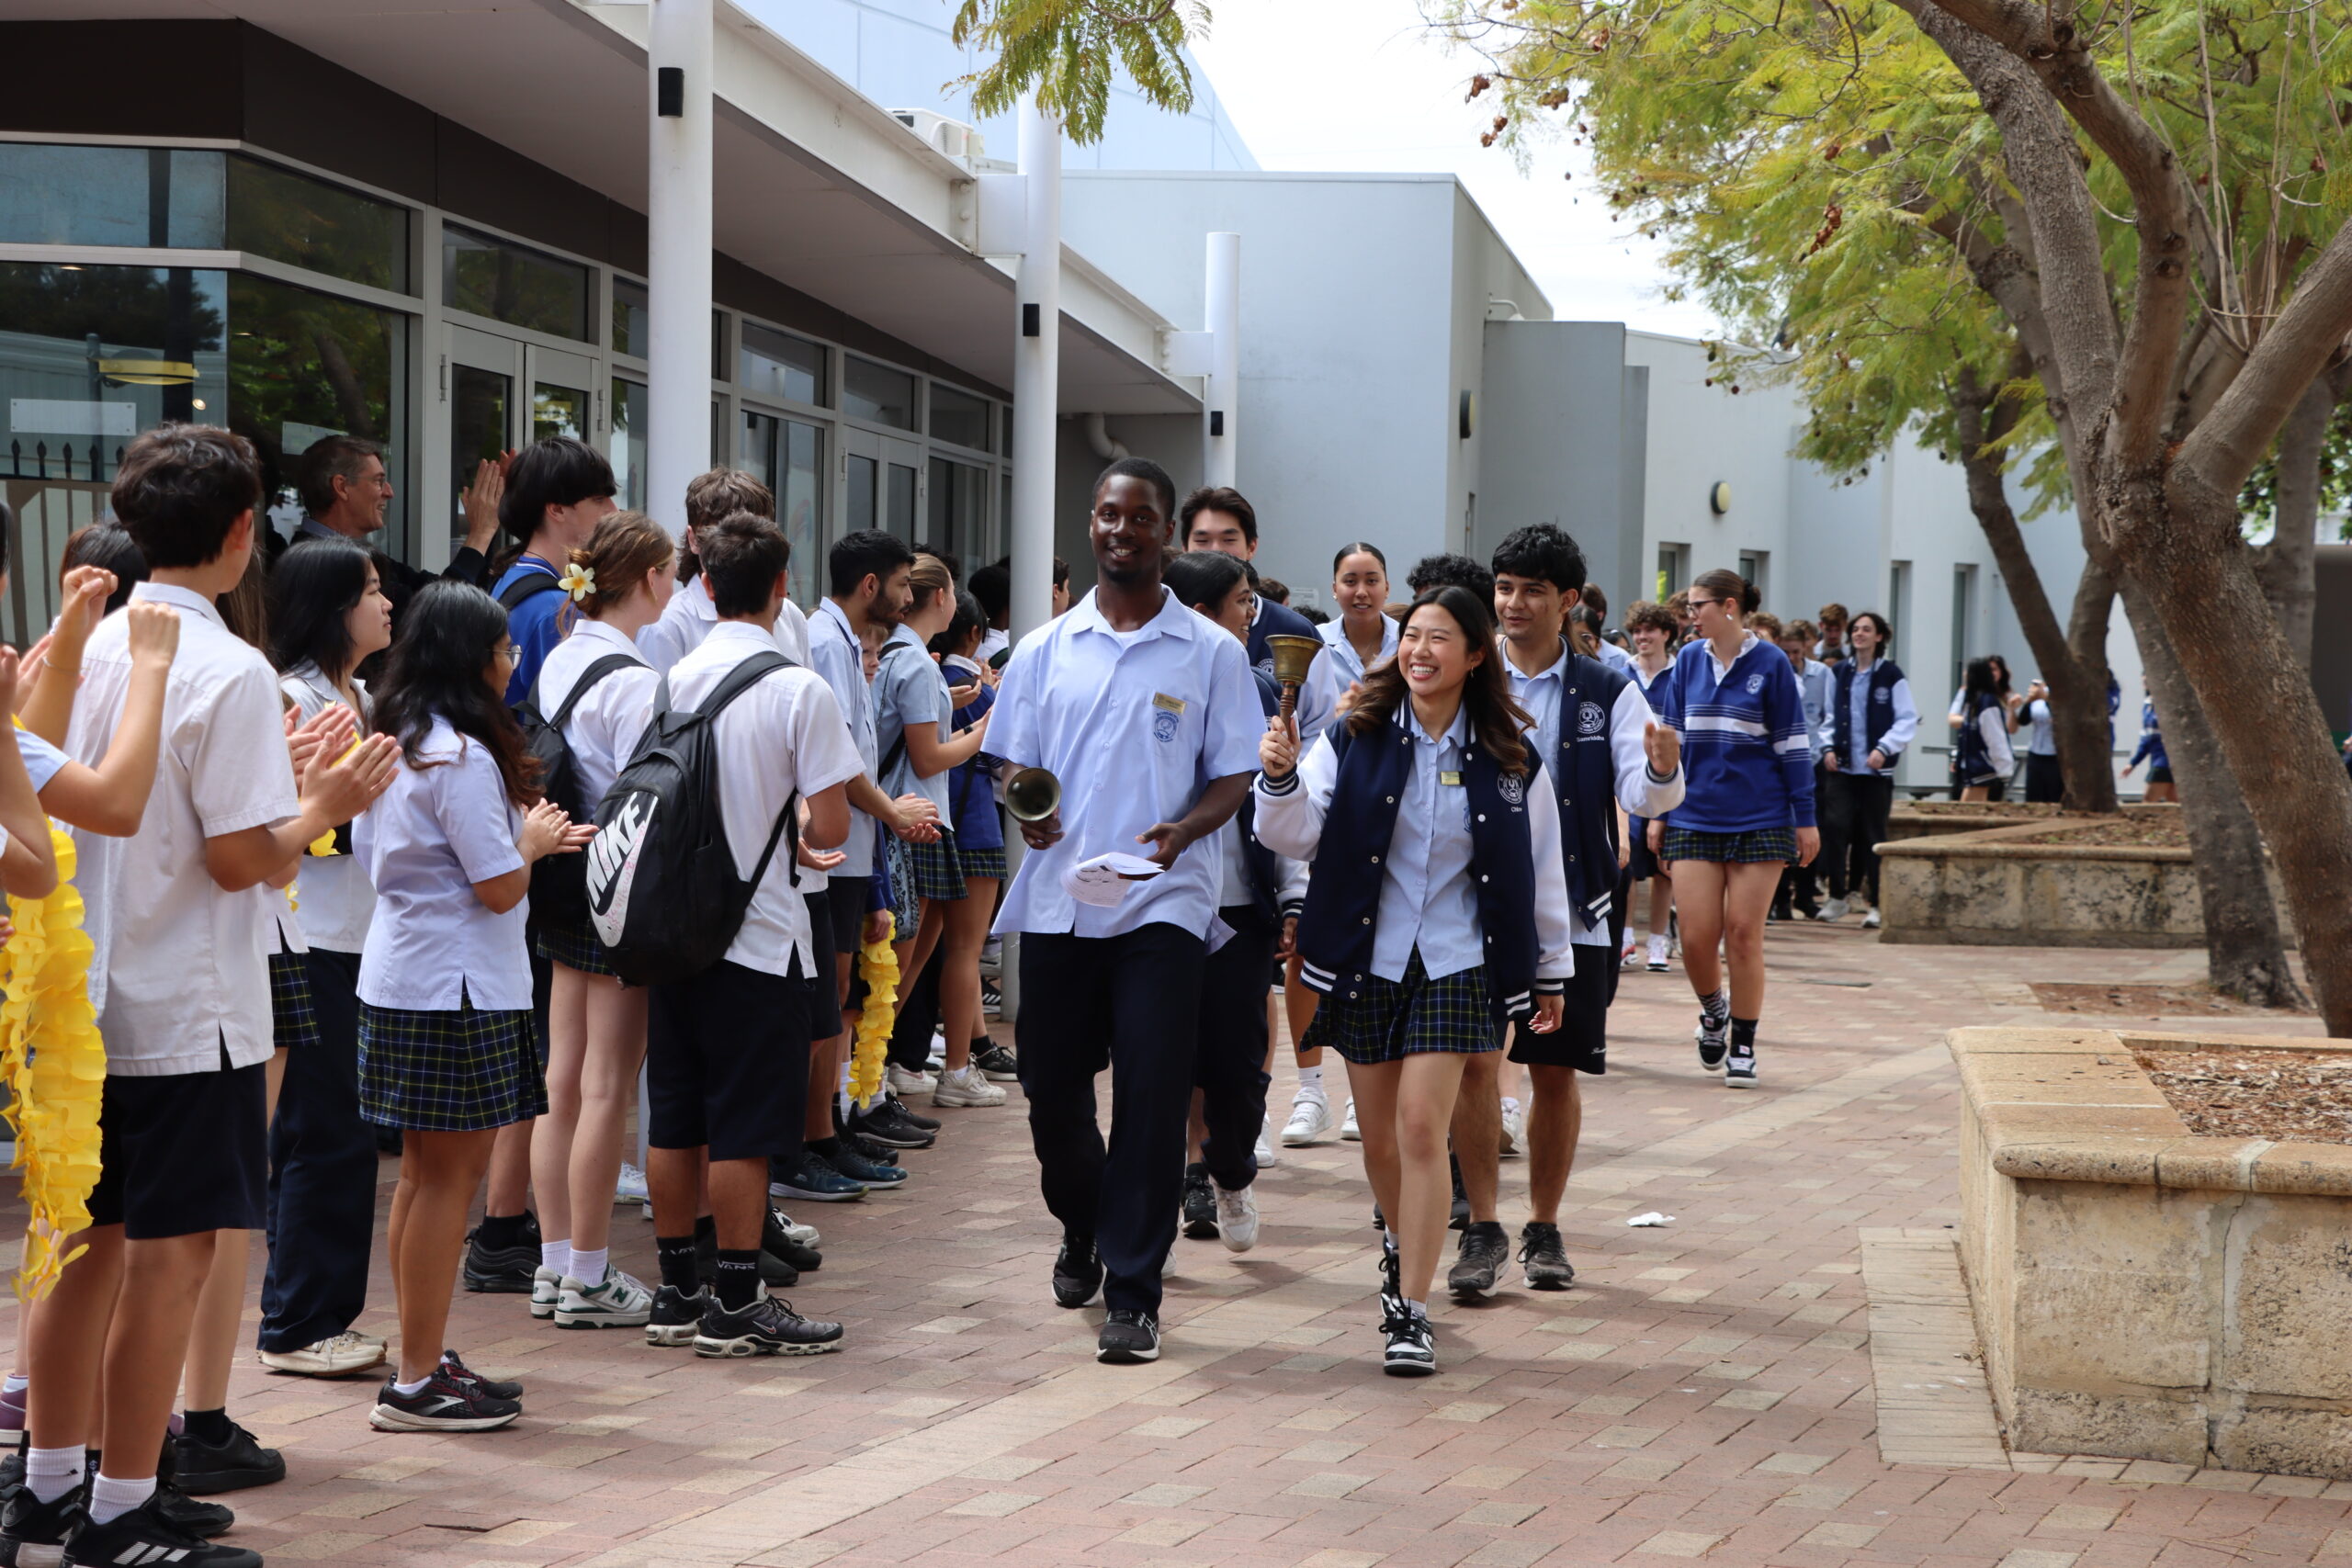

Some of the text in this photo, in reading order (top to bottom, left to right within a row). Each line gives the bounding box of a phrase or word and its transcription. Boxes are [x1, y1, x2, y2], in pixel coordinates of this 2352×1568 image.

[586, 791, 646, 908] NIKE
[717, 1258, 756, 1270] VANS
[611, 1287, 628, 1303] N
